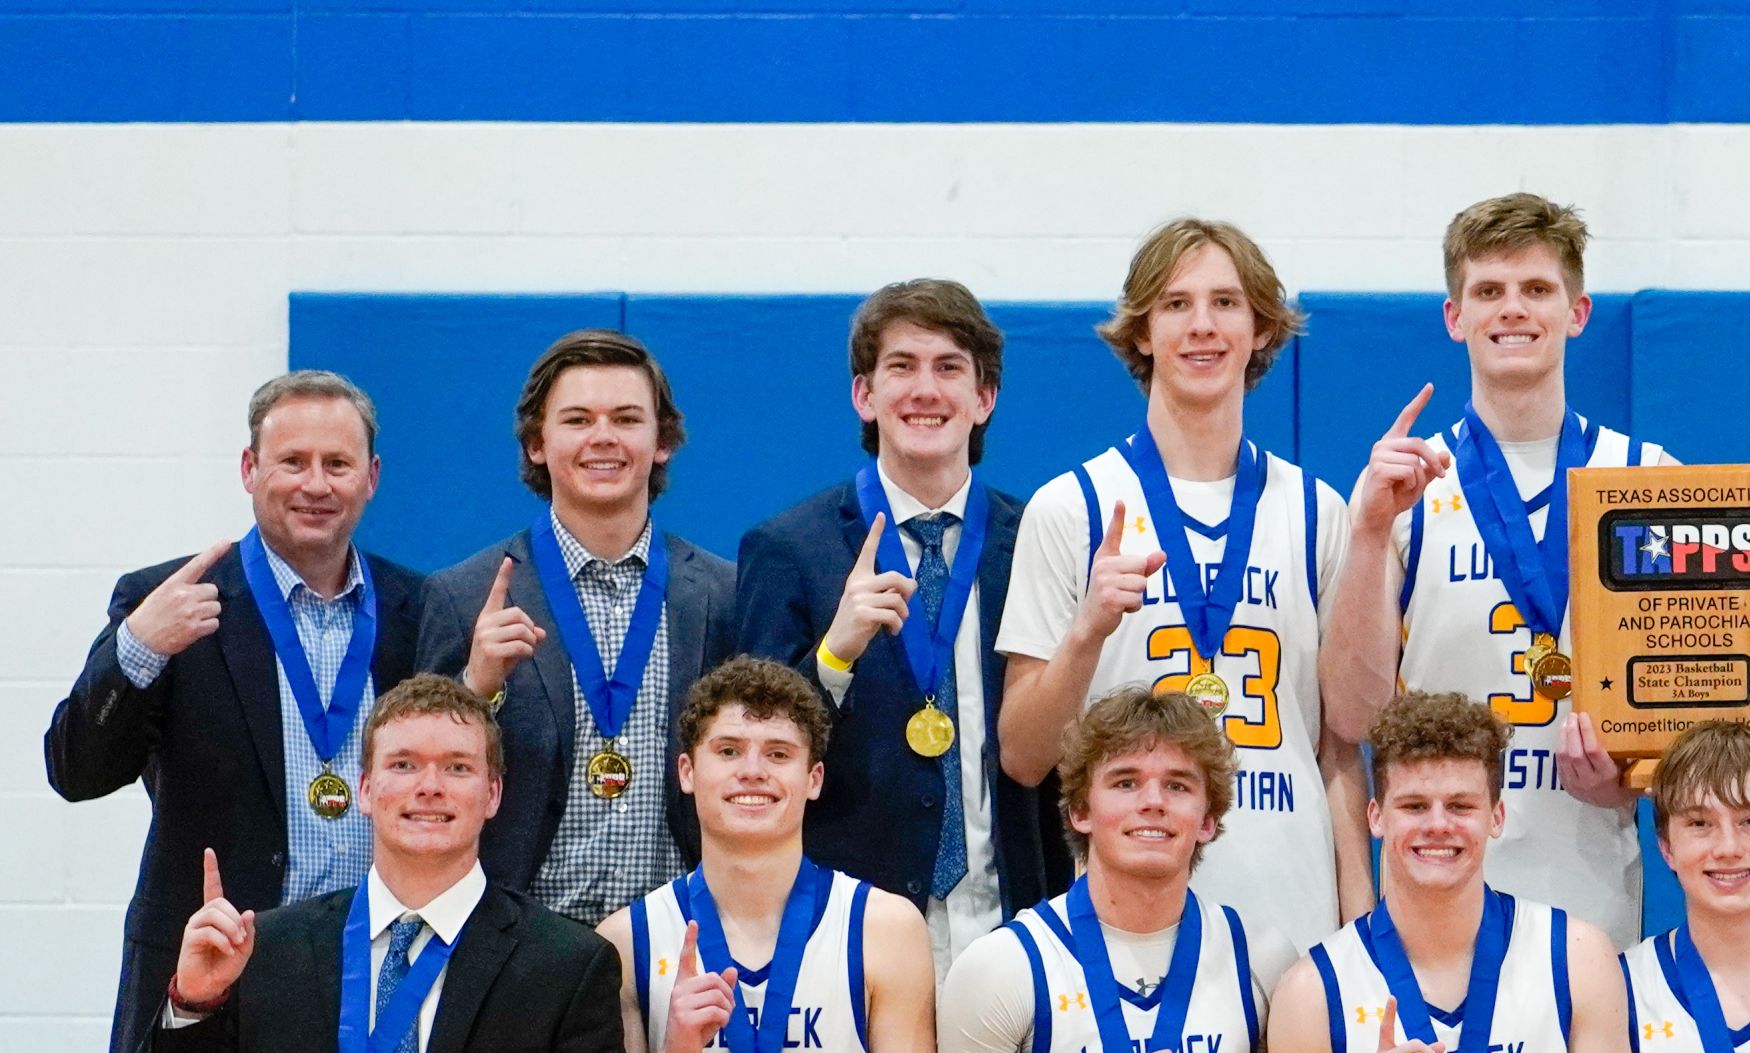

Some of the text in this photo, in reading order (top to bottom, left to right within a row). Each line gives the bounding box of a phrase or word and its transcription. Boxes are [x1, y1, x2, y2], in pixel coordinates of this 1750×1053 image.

[1596, 489, 1652, 504] TEXAS
[1638, 597, 1739, 612] OF PRIVATE
[1618, 616, 1655, 631] AND
[1646, 633, 1733, 649] SCHOOLS
[1487, 601, 1559, 727] 3
[1646, 662, 1734, 675] 2023 Basketball
[1147, 624, 1283, 749] 23
[1638, 675, 1742, 690] State Champion
[1671, 688, 1710, 700] 3A Boys
